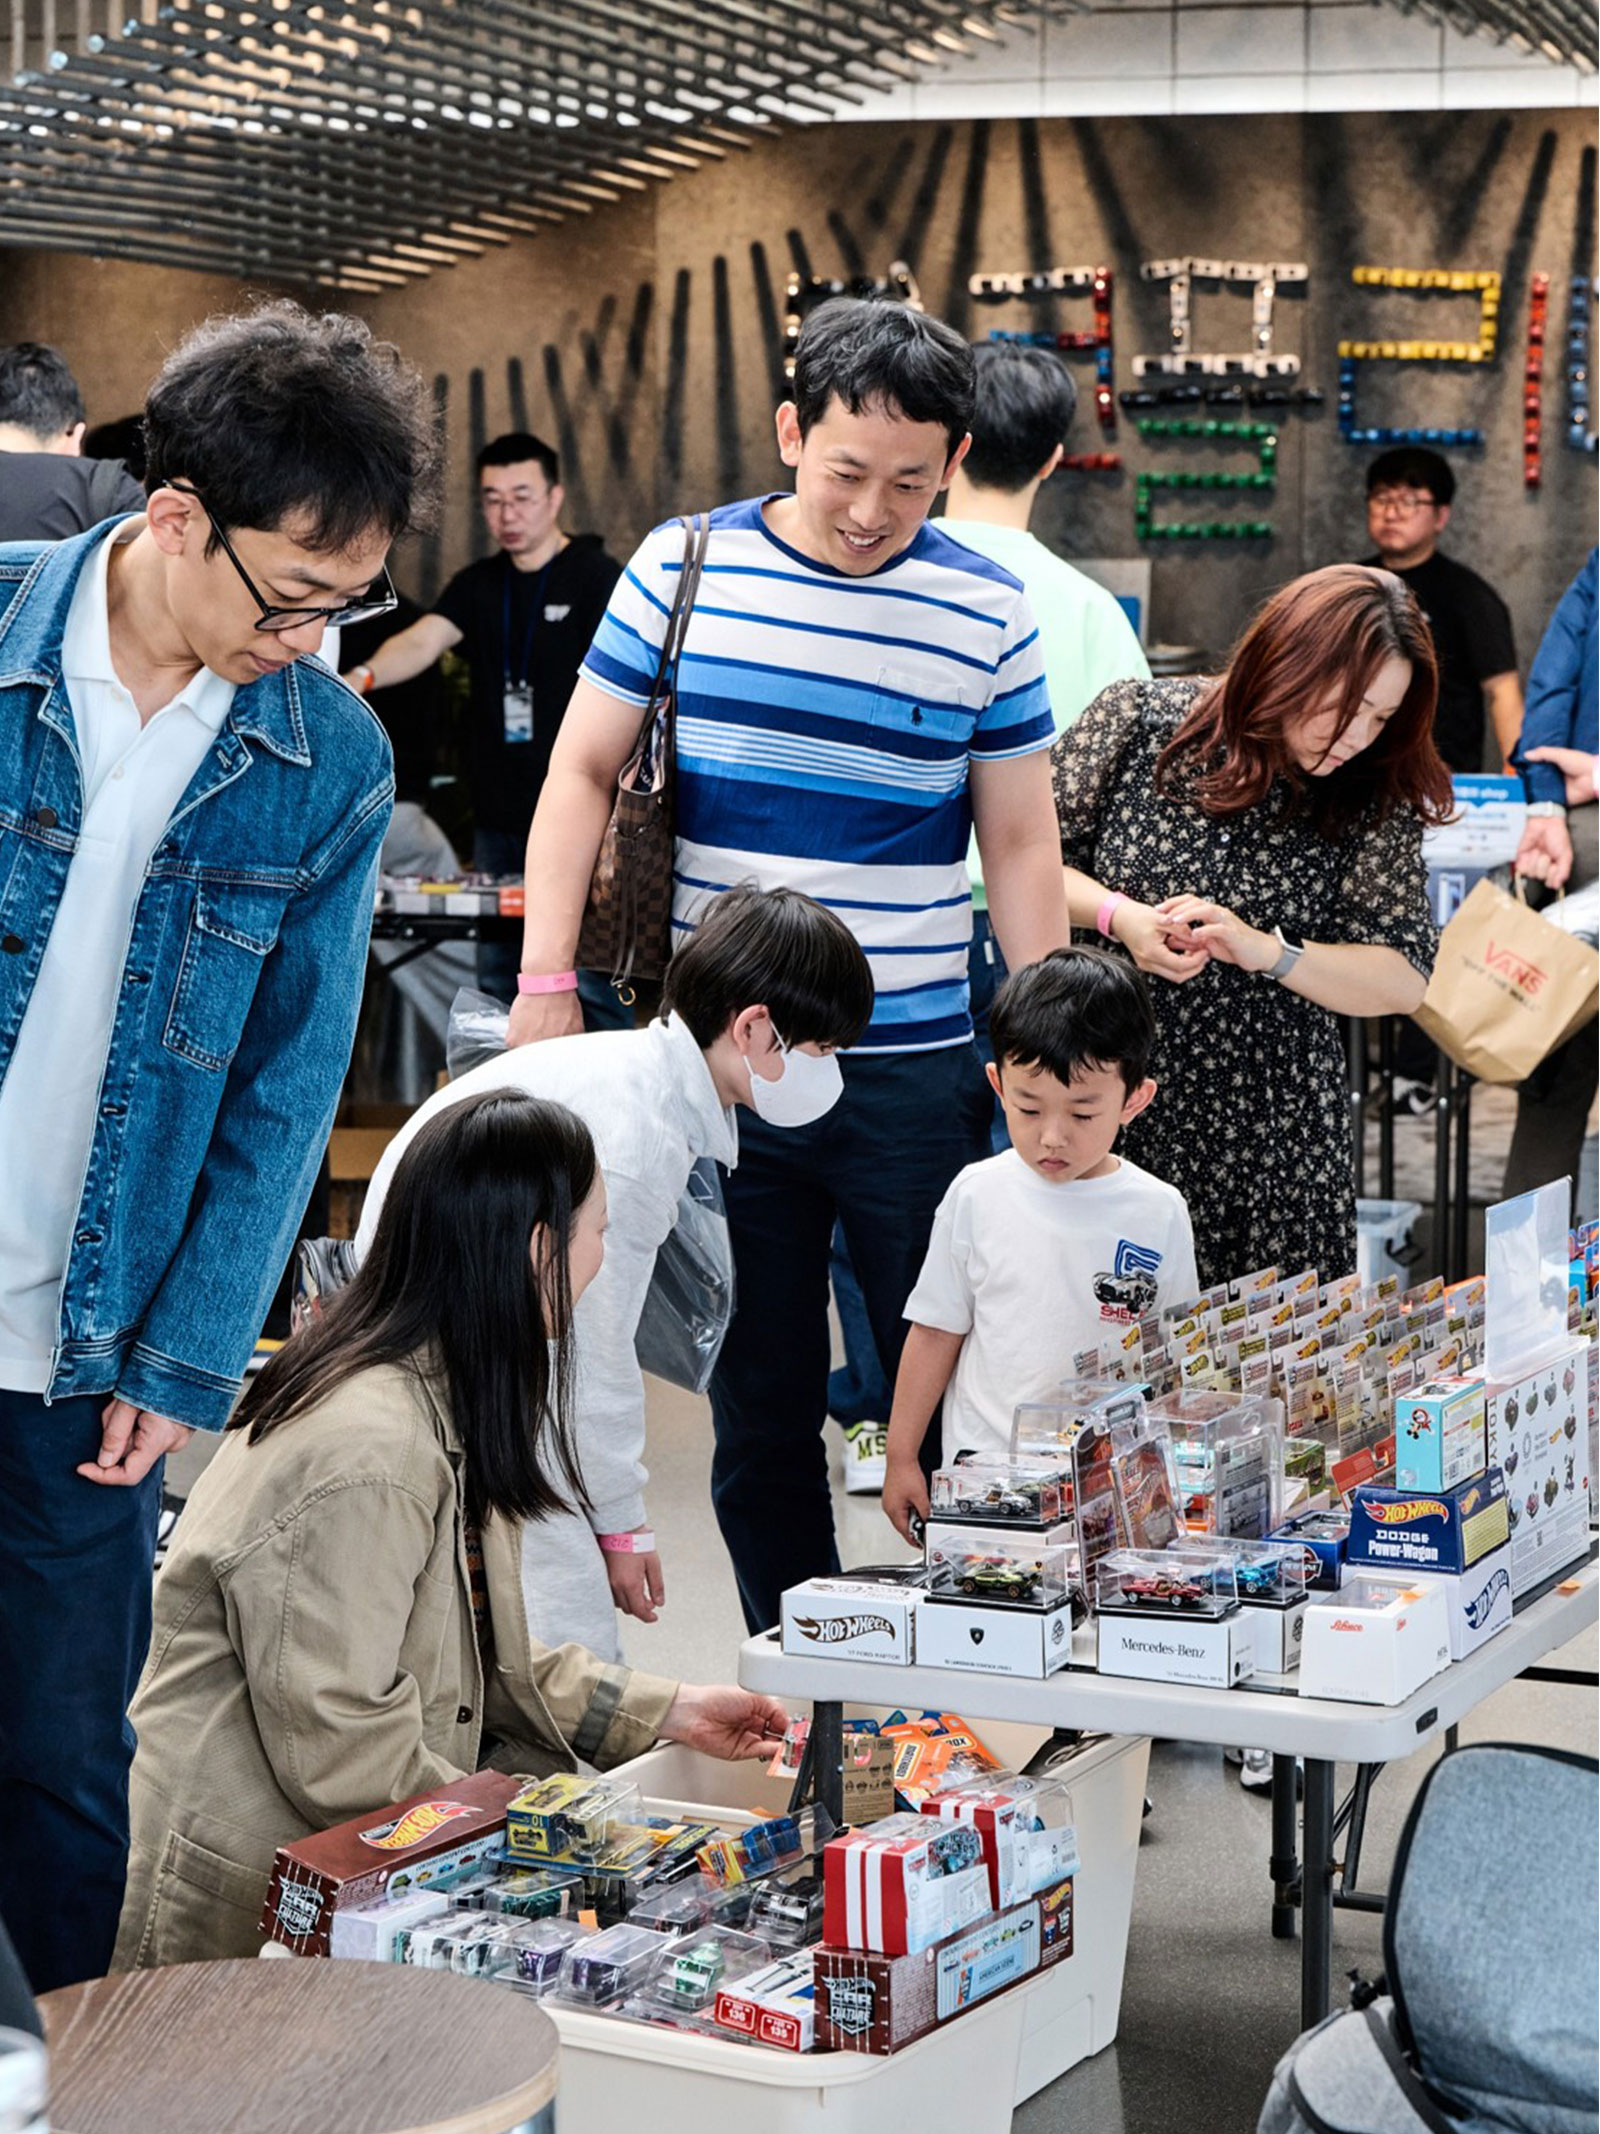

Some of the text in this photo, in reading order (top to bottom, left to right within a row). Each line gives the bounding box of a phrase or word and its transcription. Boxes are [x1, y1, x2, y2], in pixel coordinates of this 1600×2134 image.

[1484, 938, 1549, 995] VANS
[1488, 1396, 1499, 1467] TOKY
[1384, 1502, 1409, 1524] HOT
[1375, 1529, 1430, 1543] DODGE
[1368, 1540, 1439, 1563] Power-Wagon
[817, 1615, 893, 1643] HOT WHEELS
[1121, 1637, 1206, 1660] Mercedes-Benz
[282, 1893, 319, 1917] CAR
[278, 1904, 314, 1930] CULTURE
[831, 1990, 873, 2006] CAR
[830, 2005, 871, 2023] CULTURE
